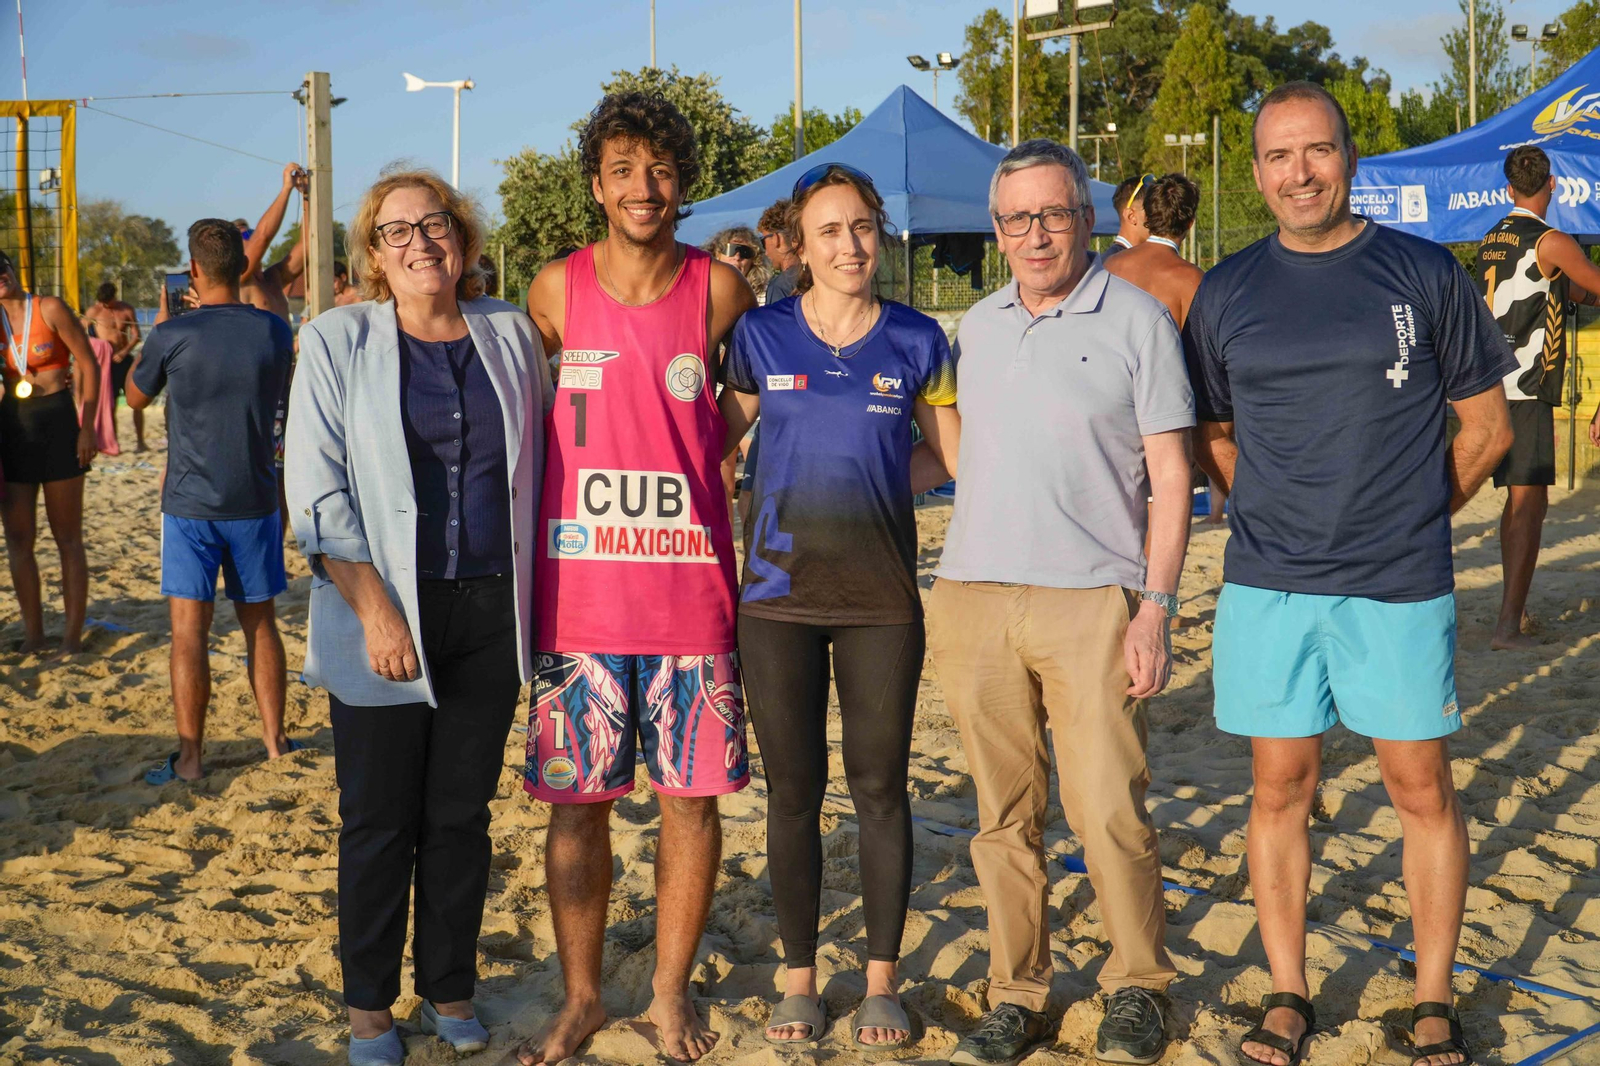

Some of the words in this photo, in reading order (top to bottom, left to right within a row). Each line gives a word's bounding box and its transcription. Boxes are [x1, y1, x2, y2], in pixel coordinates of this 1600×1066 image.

[1350, 194, 1394, 205] ONCELLO
[1364, 205, 1389, 216] VIGO
[1482, 249, 1507, 260] GÓMEZ
[1391, 304, 1410, 365] DEPORTE
[564, 351, 597, 363] SPEEDO
[870, 405, 902, 415] ABANCA
[570, 393, 587, 448] 1
[583, 473, 684, 518] CUB
[549, 710, 565, 749] 1
